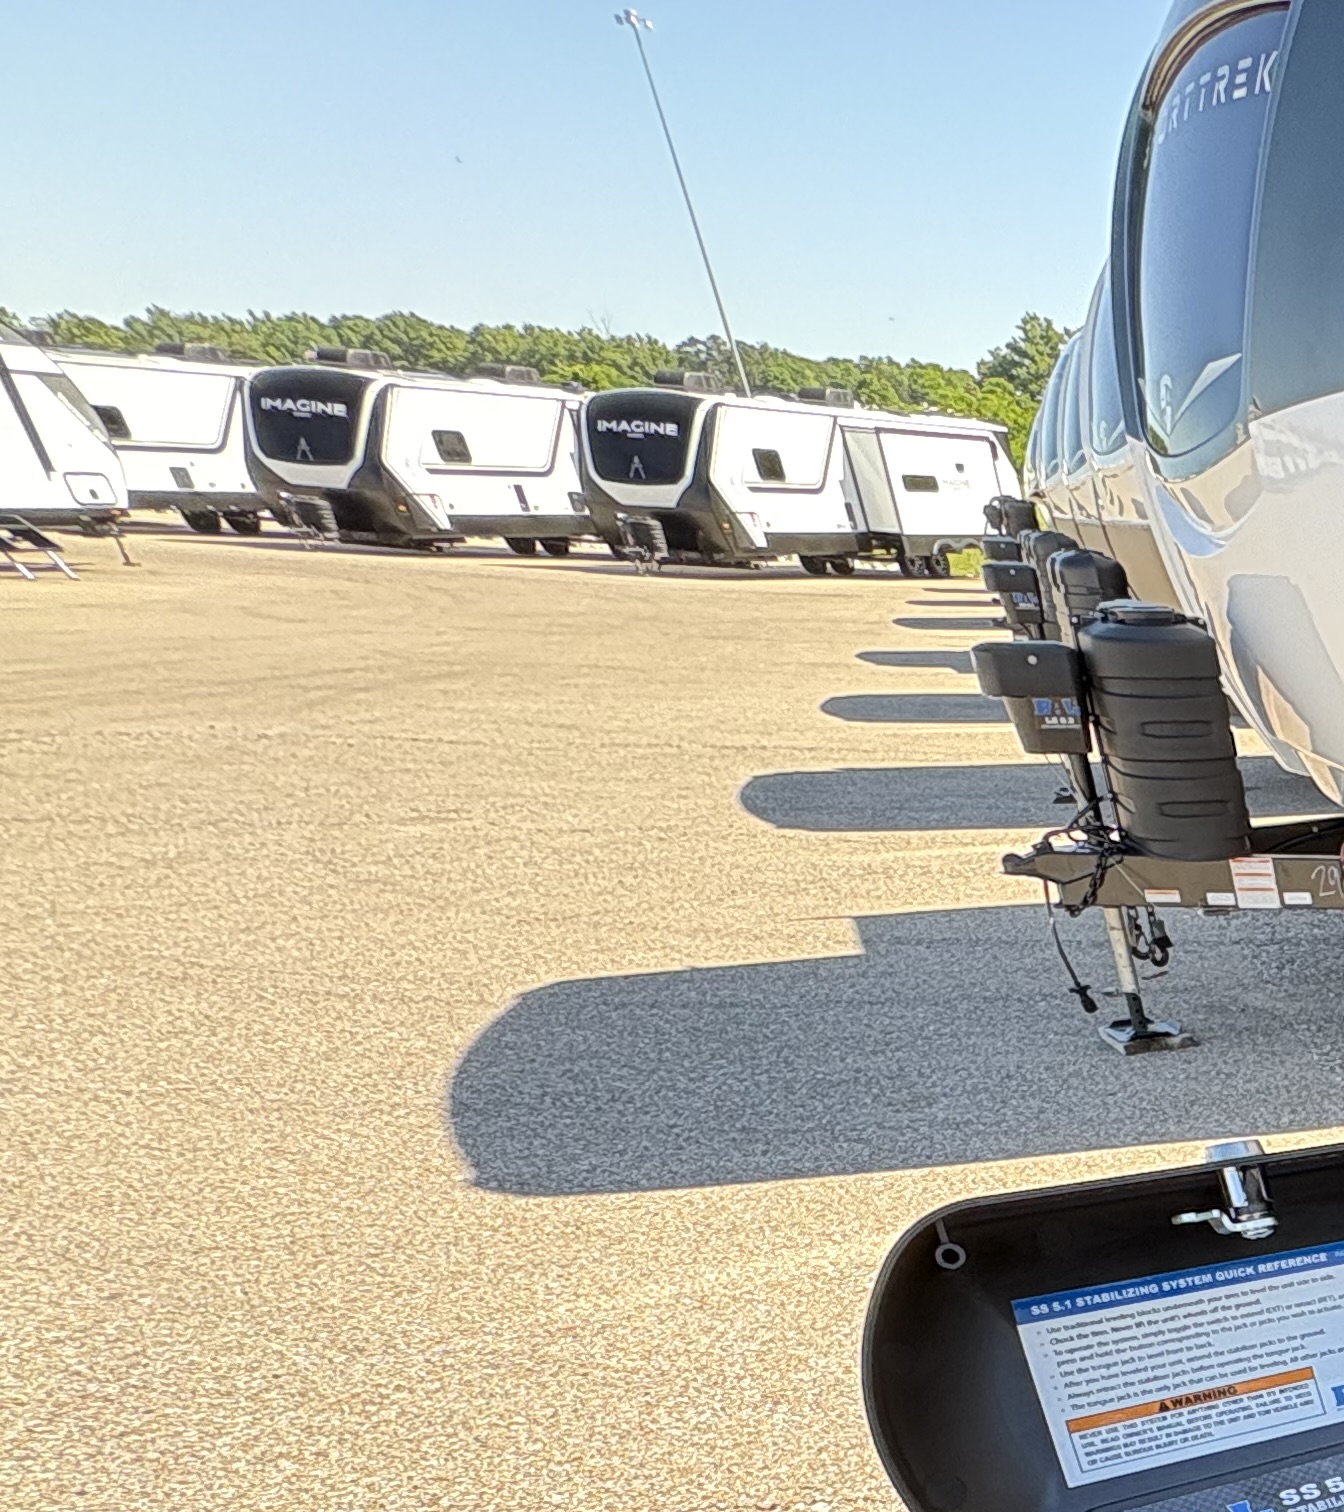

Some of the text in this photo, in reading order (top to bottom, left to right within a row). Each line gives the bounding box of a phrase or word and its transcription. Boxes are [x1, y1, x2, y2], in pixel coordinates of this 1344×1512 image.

[260, 397, 348, 418] IMAGINE
[597, 420, 679, 437] IMAGINE
[1029, 1252, 1327, 1315] SS 5.1 STABILIZING SYSTEM QUICK REFERENCE
[1170, 1385, 1238, 1408] WARNING
[1279, 1483, 1321, 1505] SS
